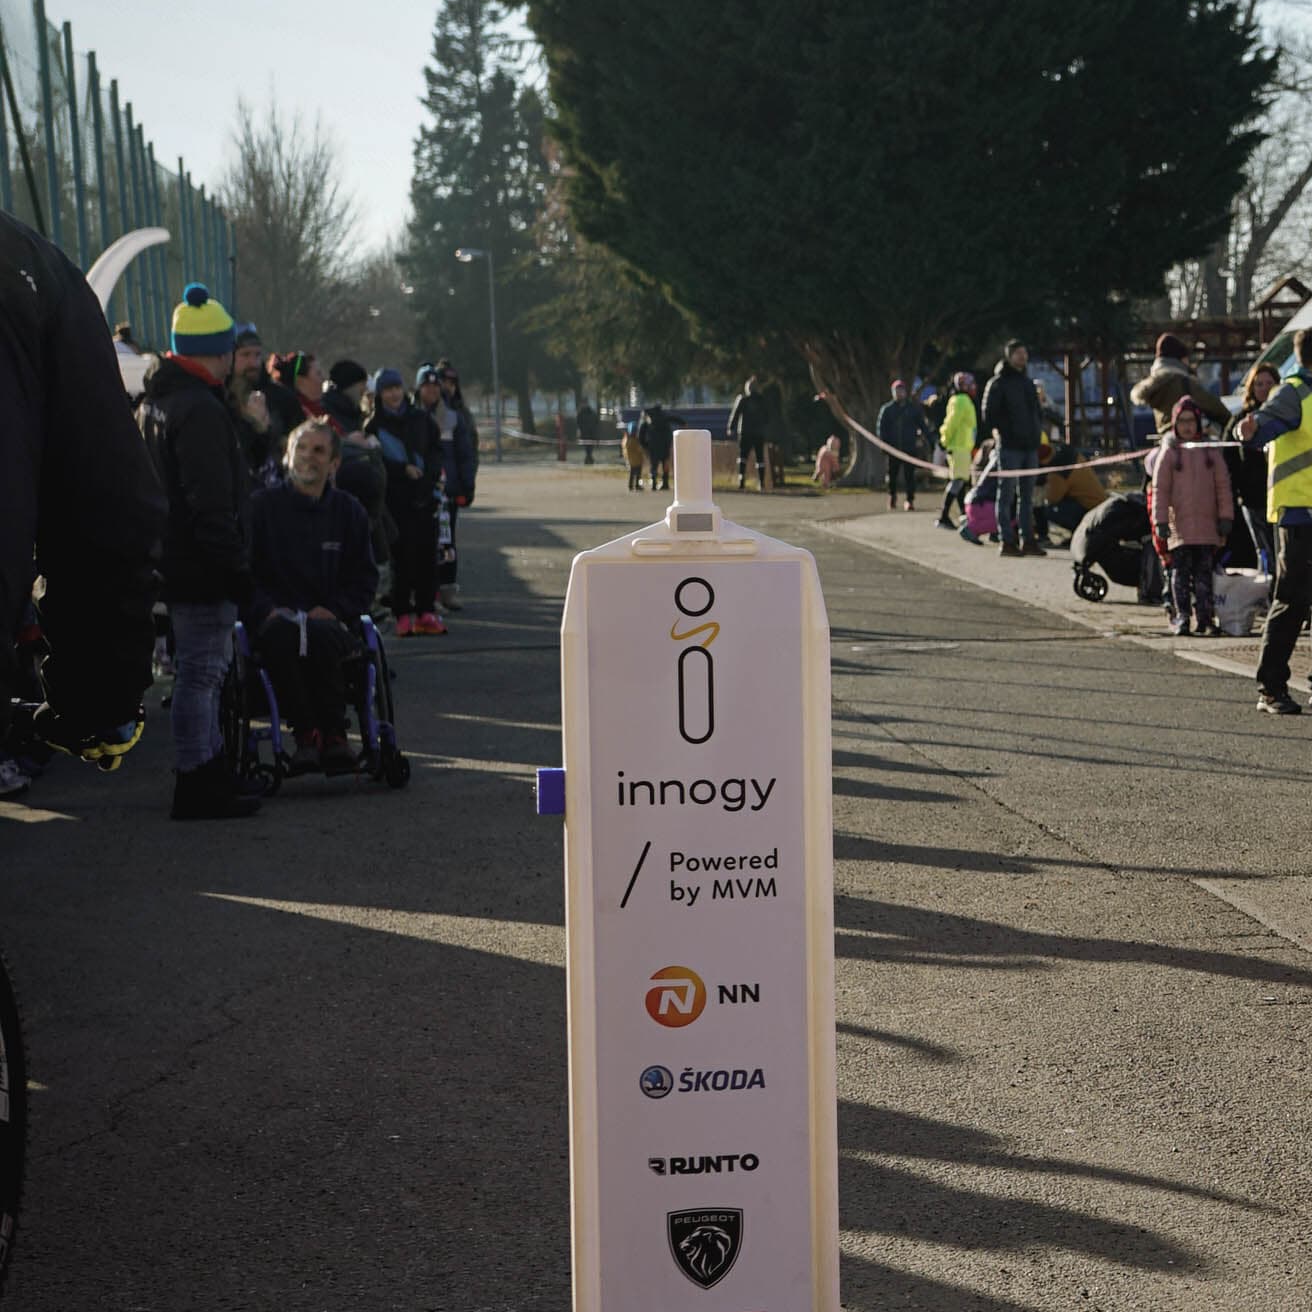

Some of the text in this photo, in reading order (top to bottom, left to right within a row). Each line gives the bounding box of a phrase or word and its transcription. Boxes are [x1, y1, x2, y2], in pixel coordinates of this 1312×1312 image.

[617, 771, 776, 812] innogy
[670, 847, 778, 872] Powered
[670, 878, 777, 907] by MVM
[718, 984, 760, 1005] NN
[678, 1068, 766, 1093] ŠKODA
[670, 1153, 760, 1176] RUNTO
[673, 1214, 736, 1225] PEUGEOT
